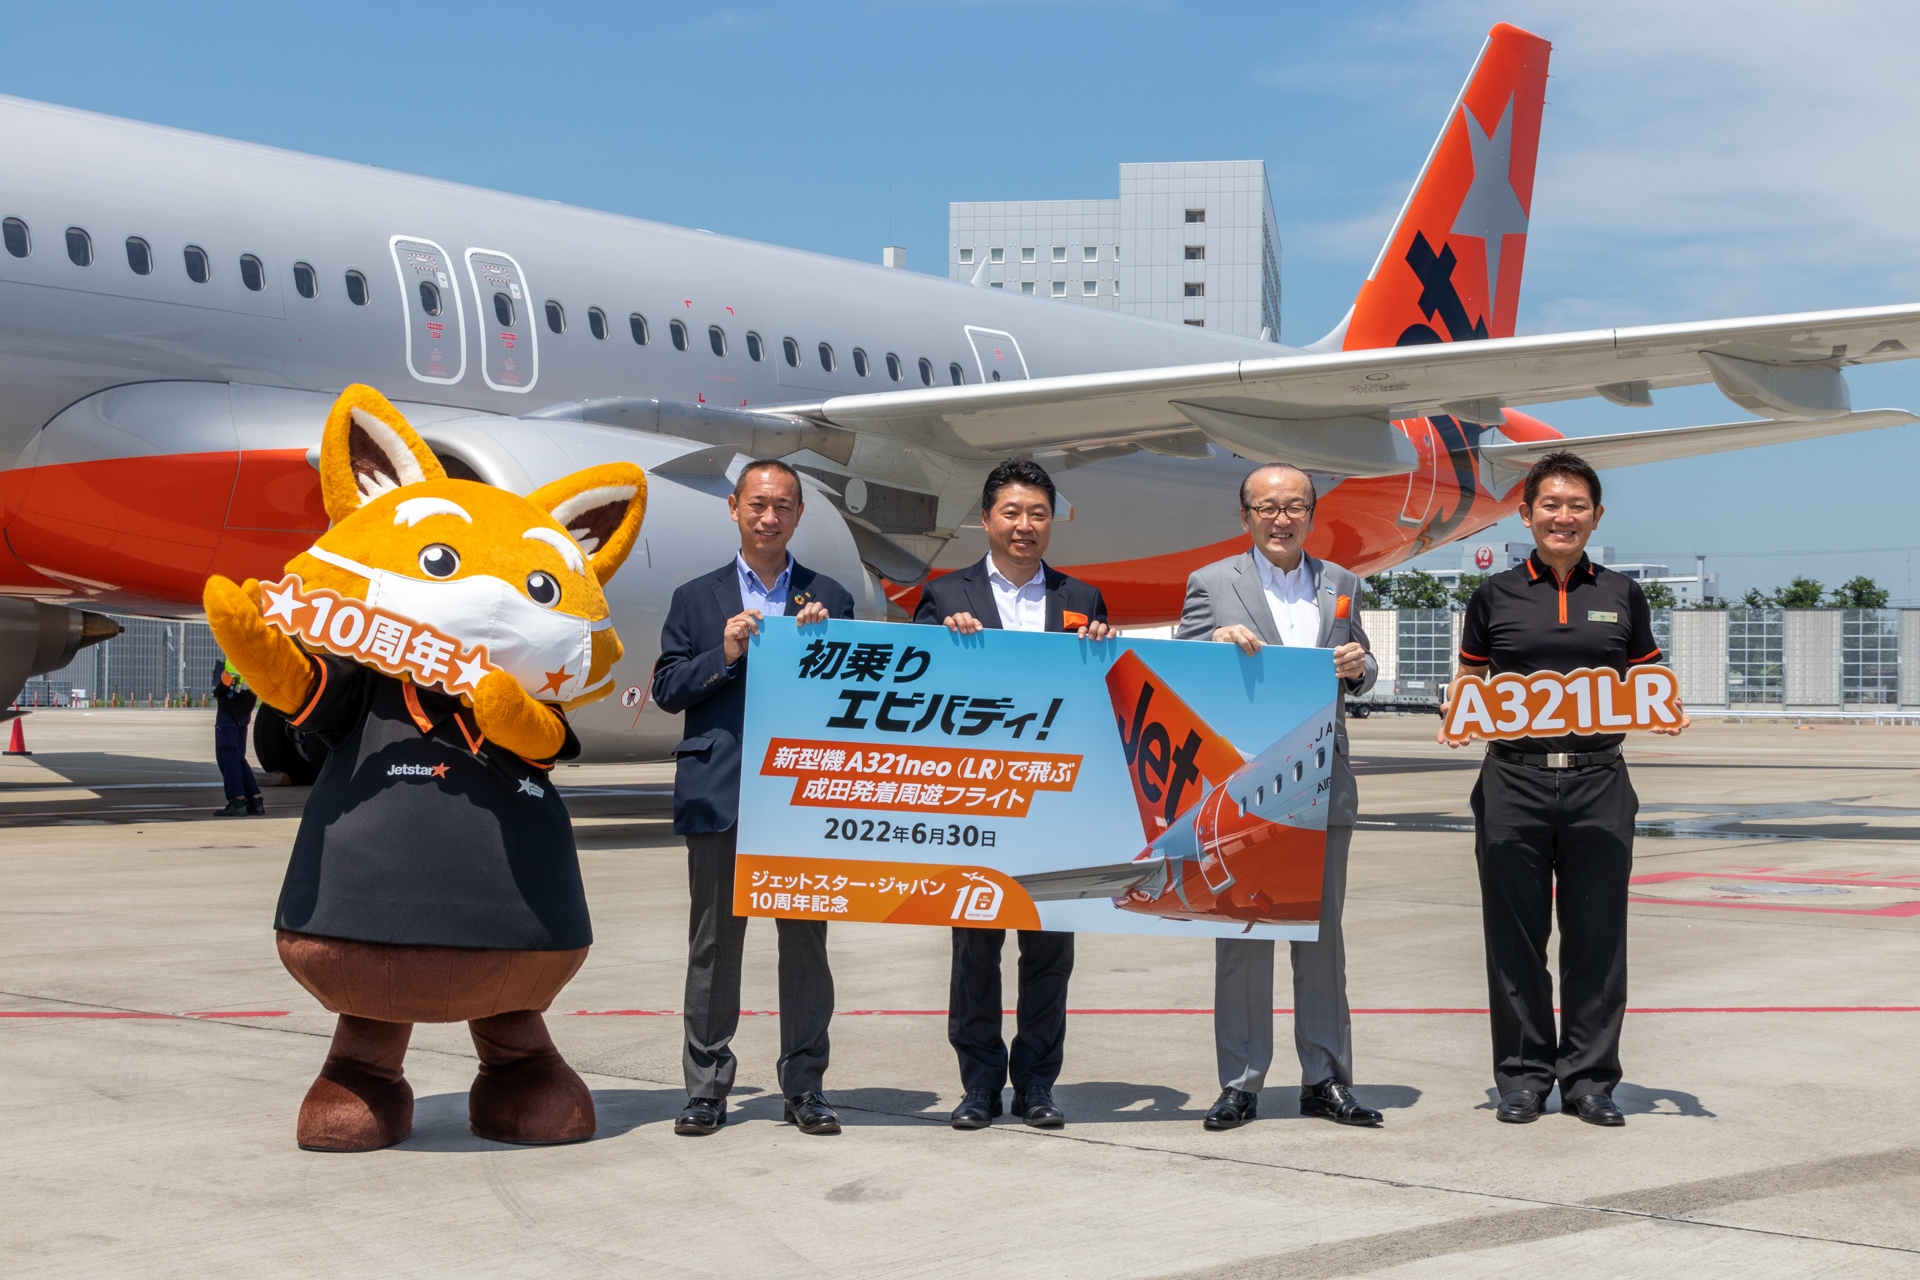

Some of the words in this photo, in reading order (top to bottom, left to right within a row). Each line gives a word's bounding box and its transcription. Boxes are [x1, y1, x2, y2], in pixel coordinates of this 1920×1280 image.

[309, 597, 456, 677] 10周年
[798, 639, 931, 683] 初乗り
[826, 689, 1063, 740] エビバディ!
[1450, 673, 1676, 735] A321LR
[387, 764, 433, 776] Jetstar
[1118, 680, 1203, 826] Jet
[802, 778, 1025, 809] 成田発着周遊フライト
[824, 818, 996, 848] 2022年6月30日
[751, 871, 946, 896] ジェットスター・ジャパン
[749, 892, 849, 913] 10周年記念
